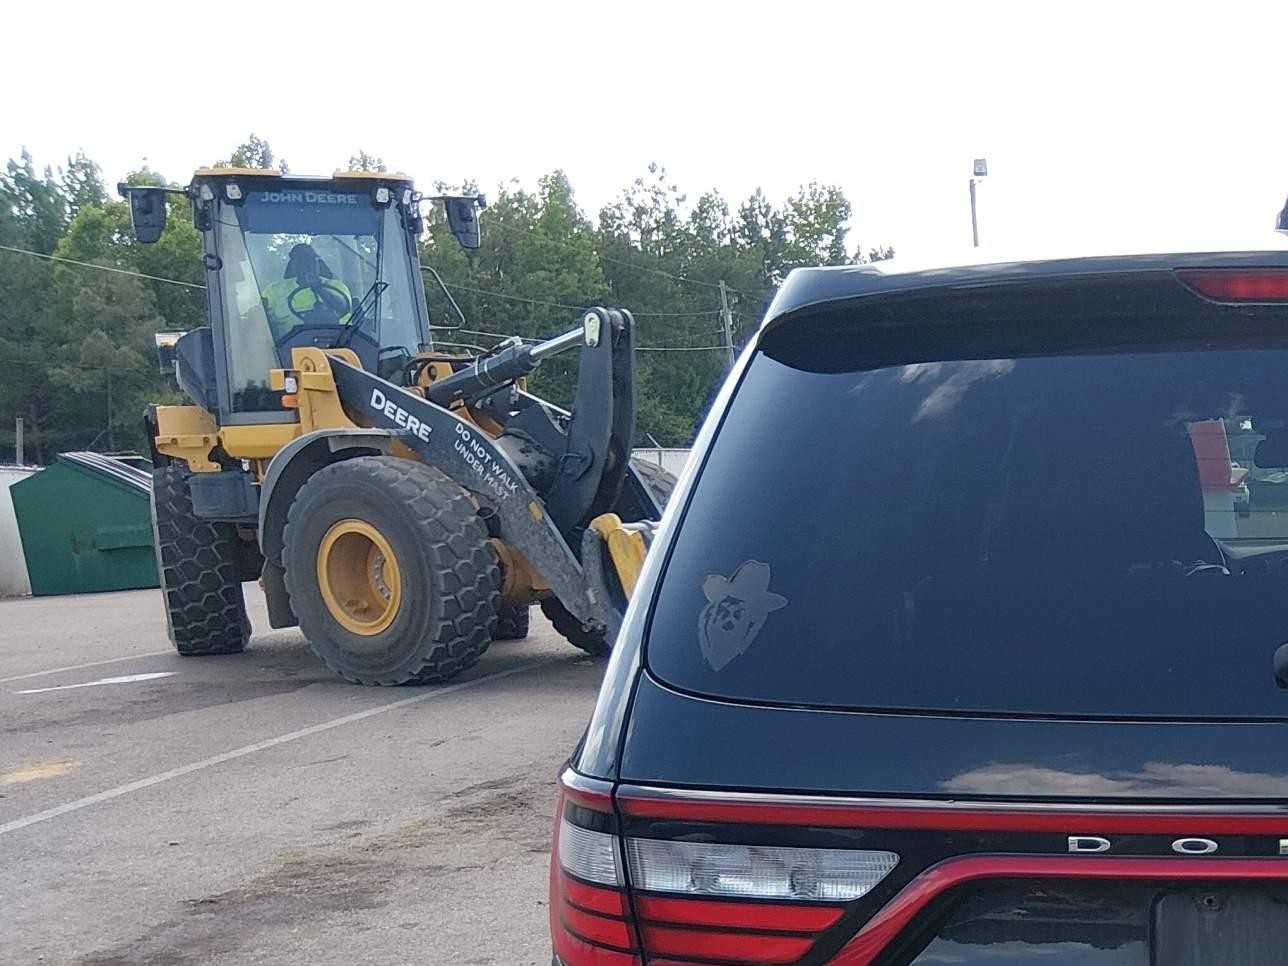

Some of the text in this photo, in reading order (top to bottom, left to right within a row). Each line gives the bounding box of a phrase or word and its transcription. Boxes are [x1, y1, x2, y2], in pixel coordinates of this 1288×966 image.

[261, 192, 357, 204] JOHN DEERE
[370, 388, 432, 442] DEERE
[454, 439, 511, 500] UNDER MAST
[455, 423, 519, 494] DO NOT WALK
